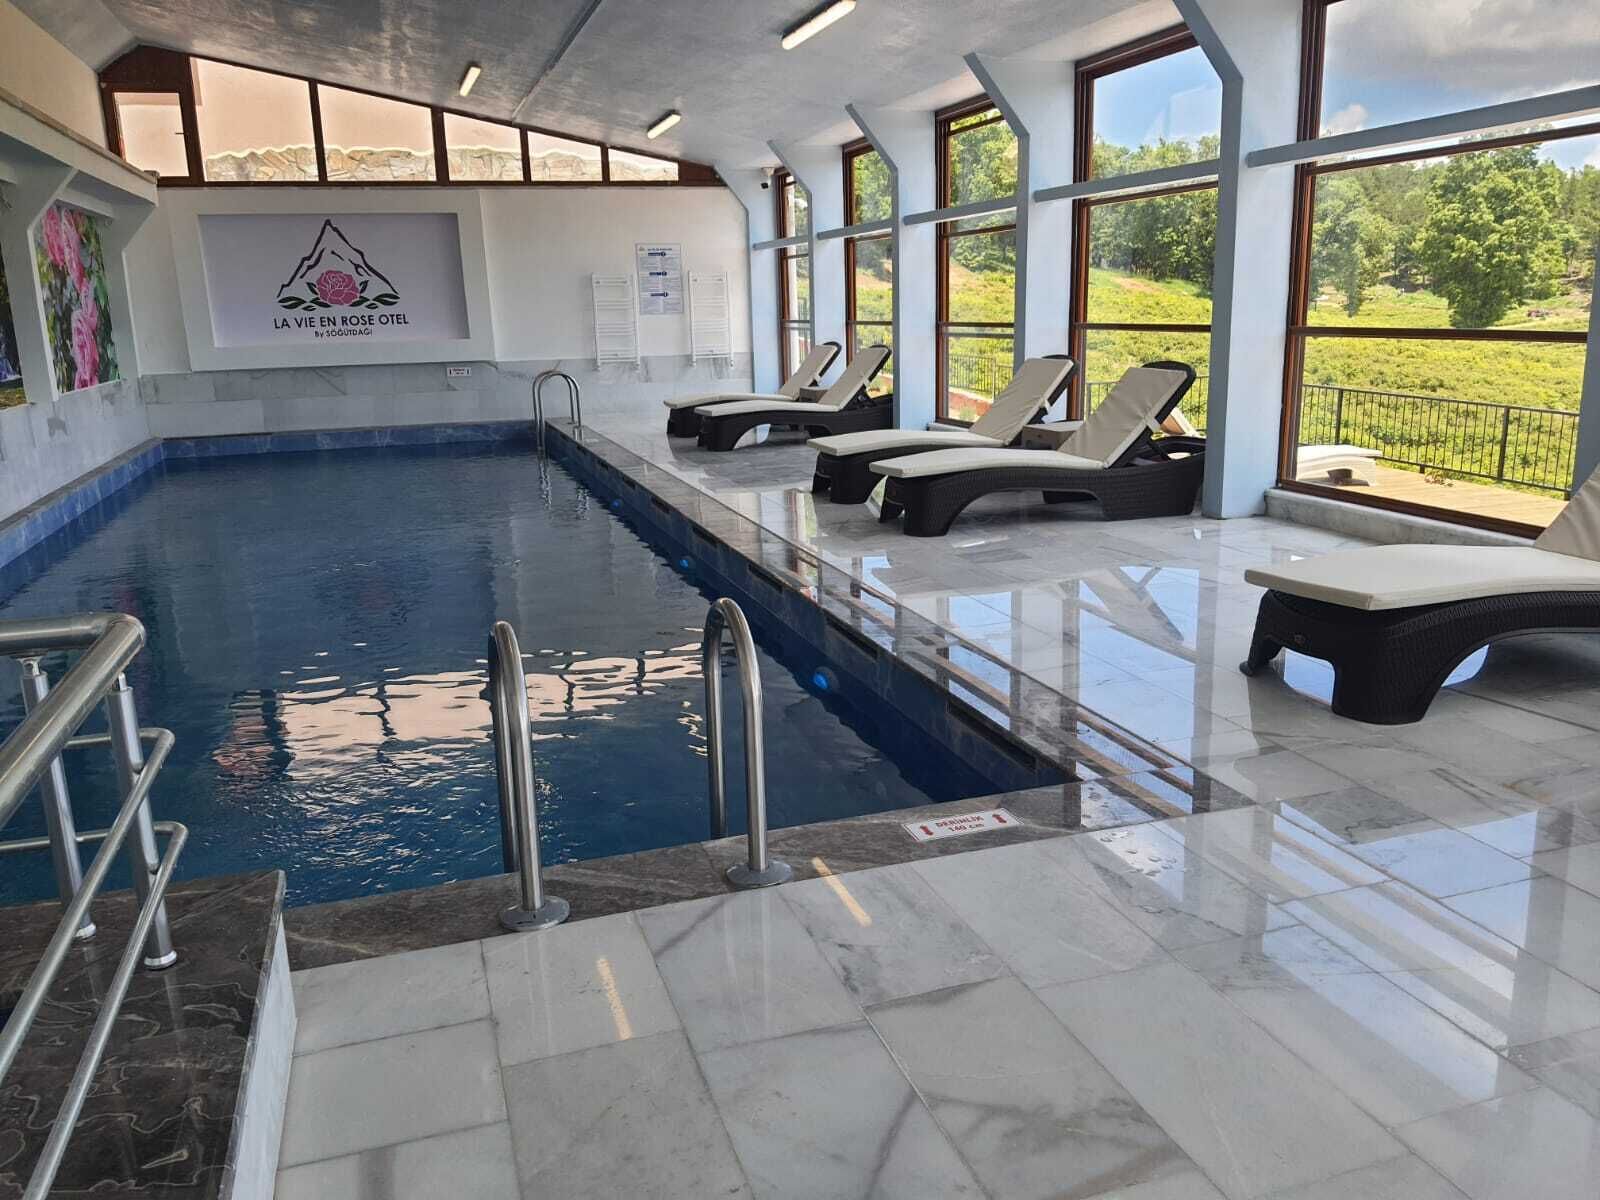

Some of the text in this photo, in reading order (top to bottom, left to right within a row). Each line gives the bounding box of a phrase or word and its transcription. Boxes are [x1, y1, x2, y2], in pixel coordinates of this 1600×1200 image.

[274, 313, 409, 329] LA VIE EN ROSE OTEL
